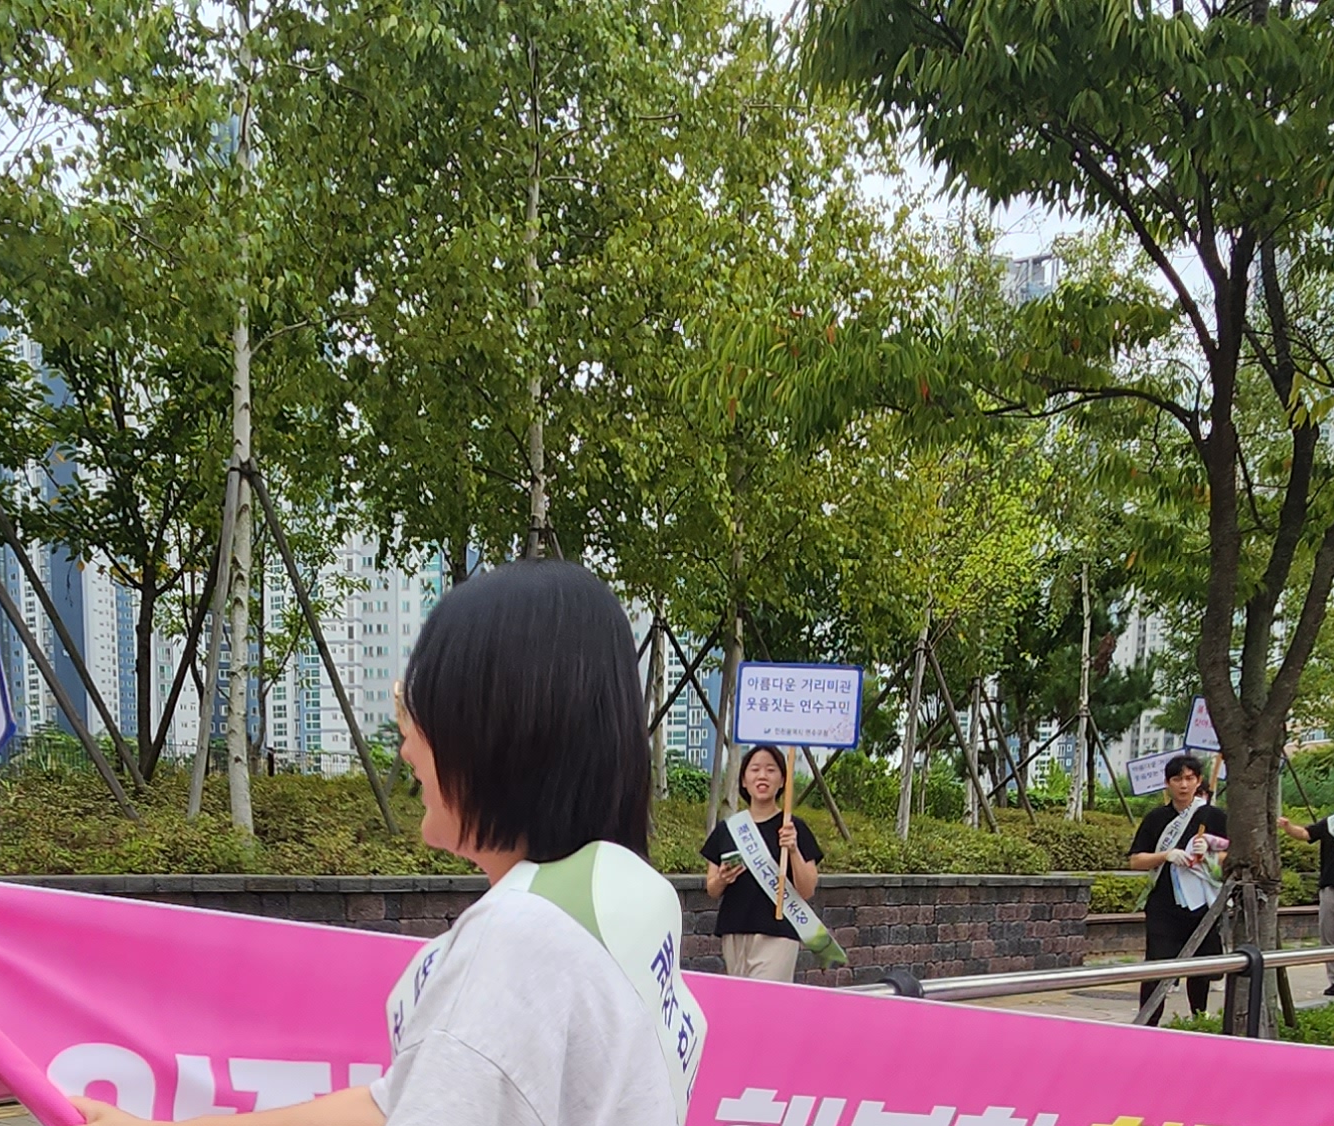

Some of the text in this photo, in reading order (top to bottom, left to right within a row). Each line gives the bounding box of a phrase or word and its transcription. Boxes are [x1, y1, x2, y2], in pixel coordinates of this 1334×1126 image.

[748, 677, 851, 694] 아름다운 거리미관
[746, 697, 850, 715] 웃음짓는 연수구민
[787, 900, 809, 925] 조성
